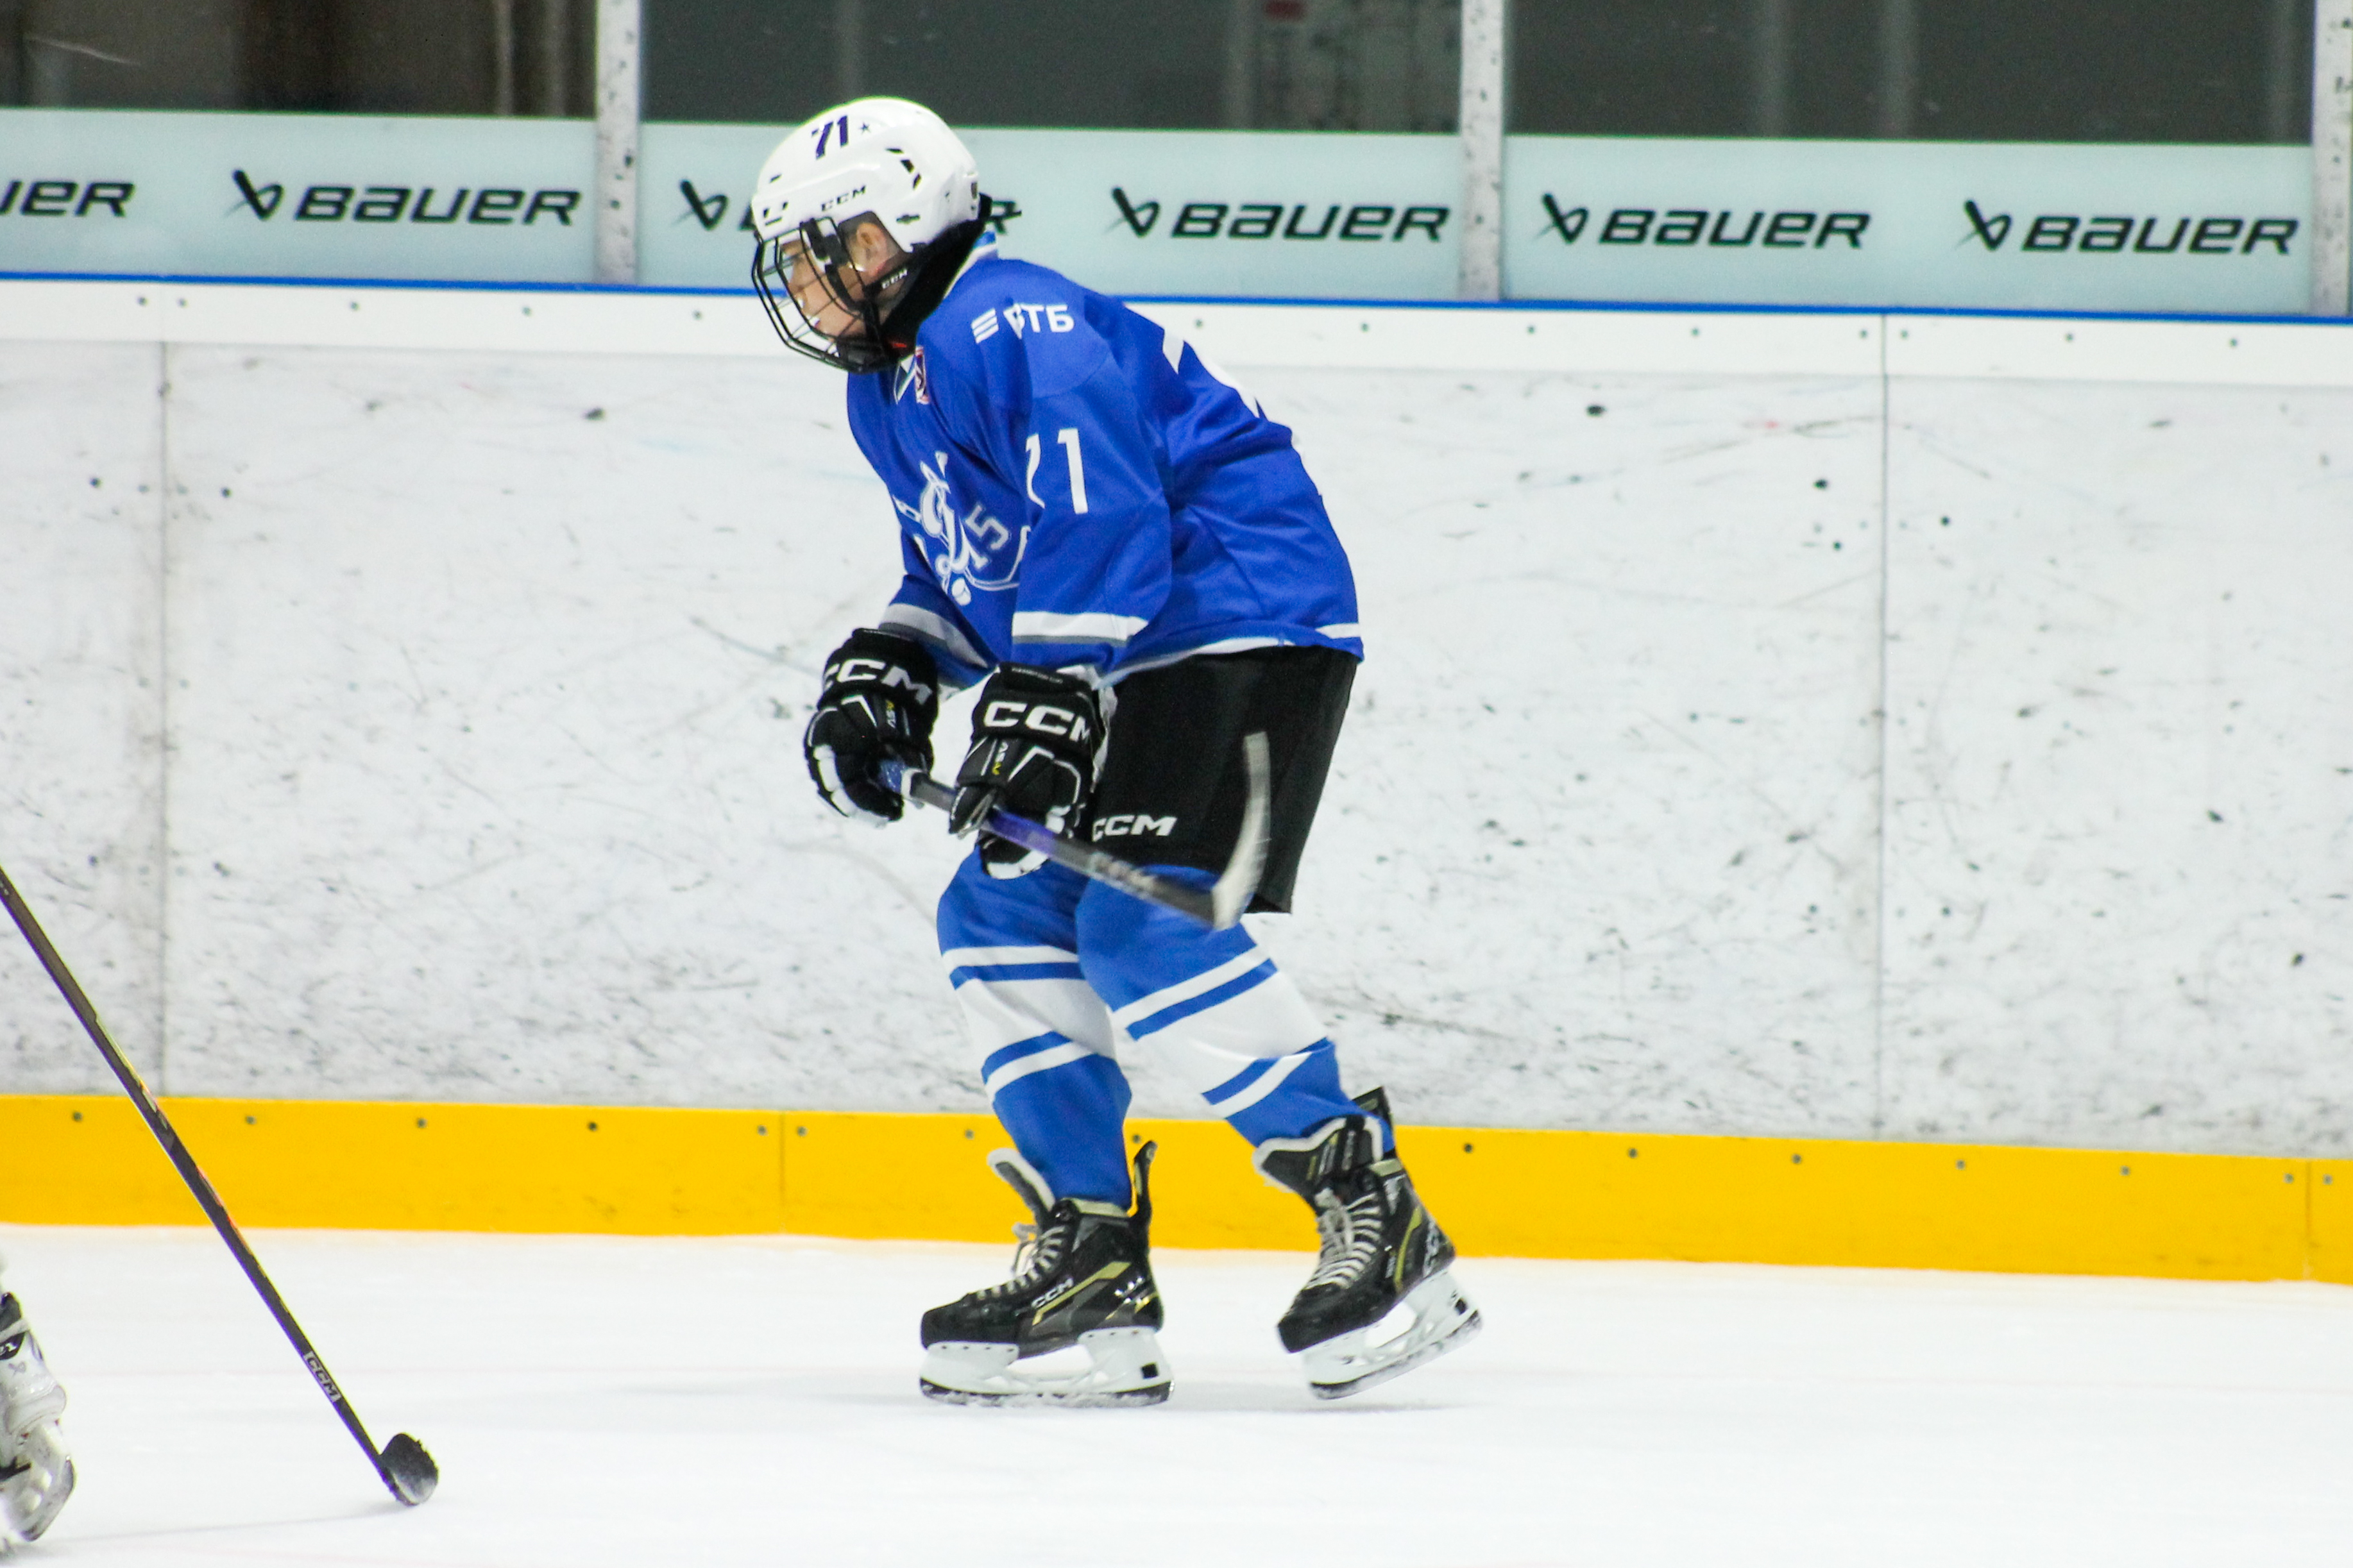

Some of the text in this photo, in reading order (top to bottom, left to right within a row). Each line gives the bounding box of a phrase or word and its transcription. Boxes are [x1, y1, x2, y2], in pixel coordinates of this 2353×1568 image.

[811, 115, 849, 160] 71
[821, 185, 866, 211] CCM
[1031, 1277, 1075, 1309] CCM
[306, 1356, 339, 1396] CCM
